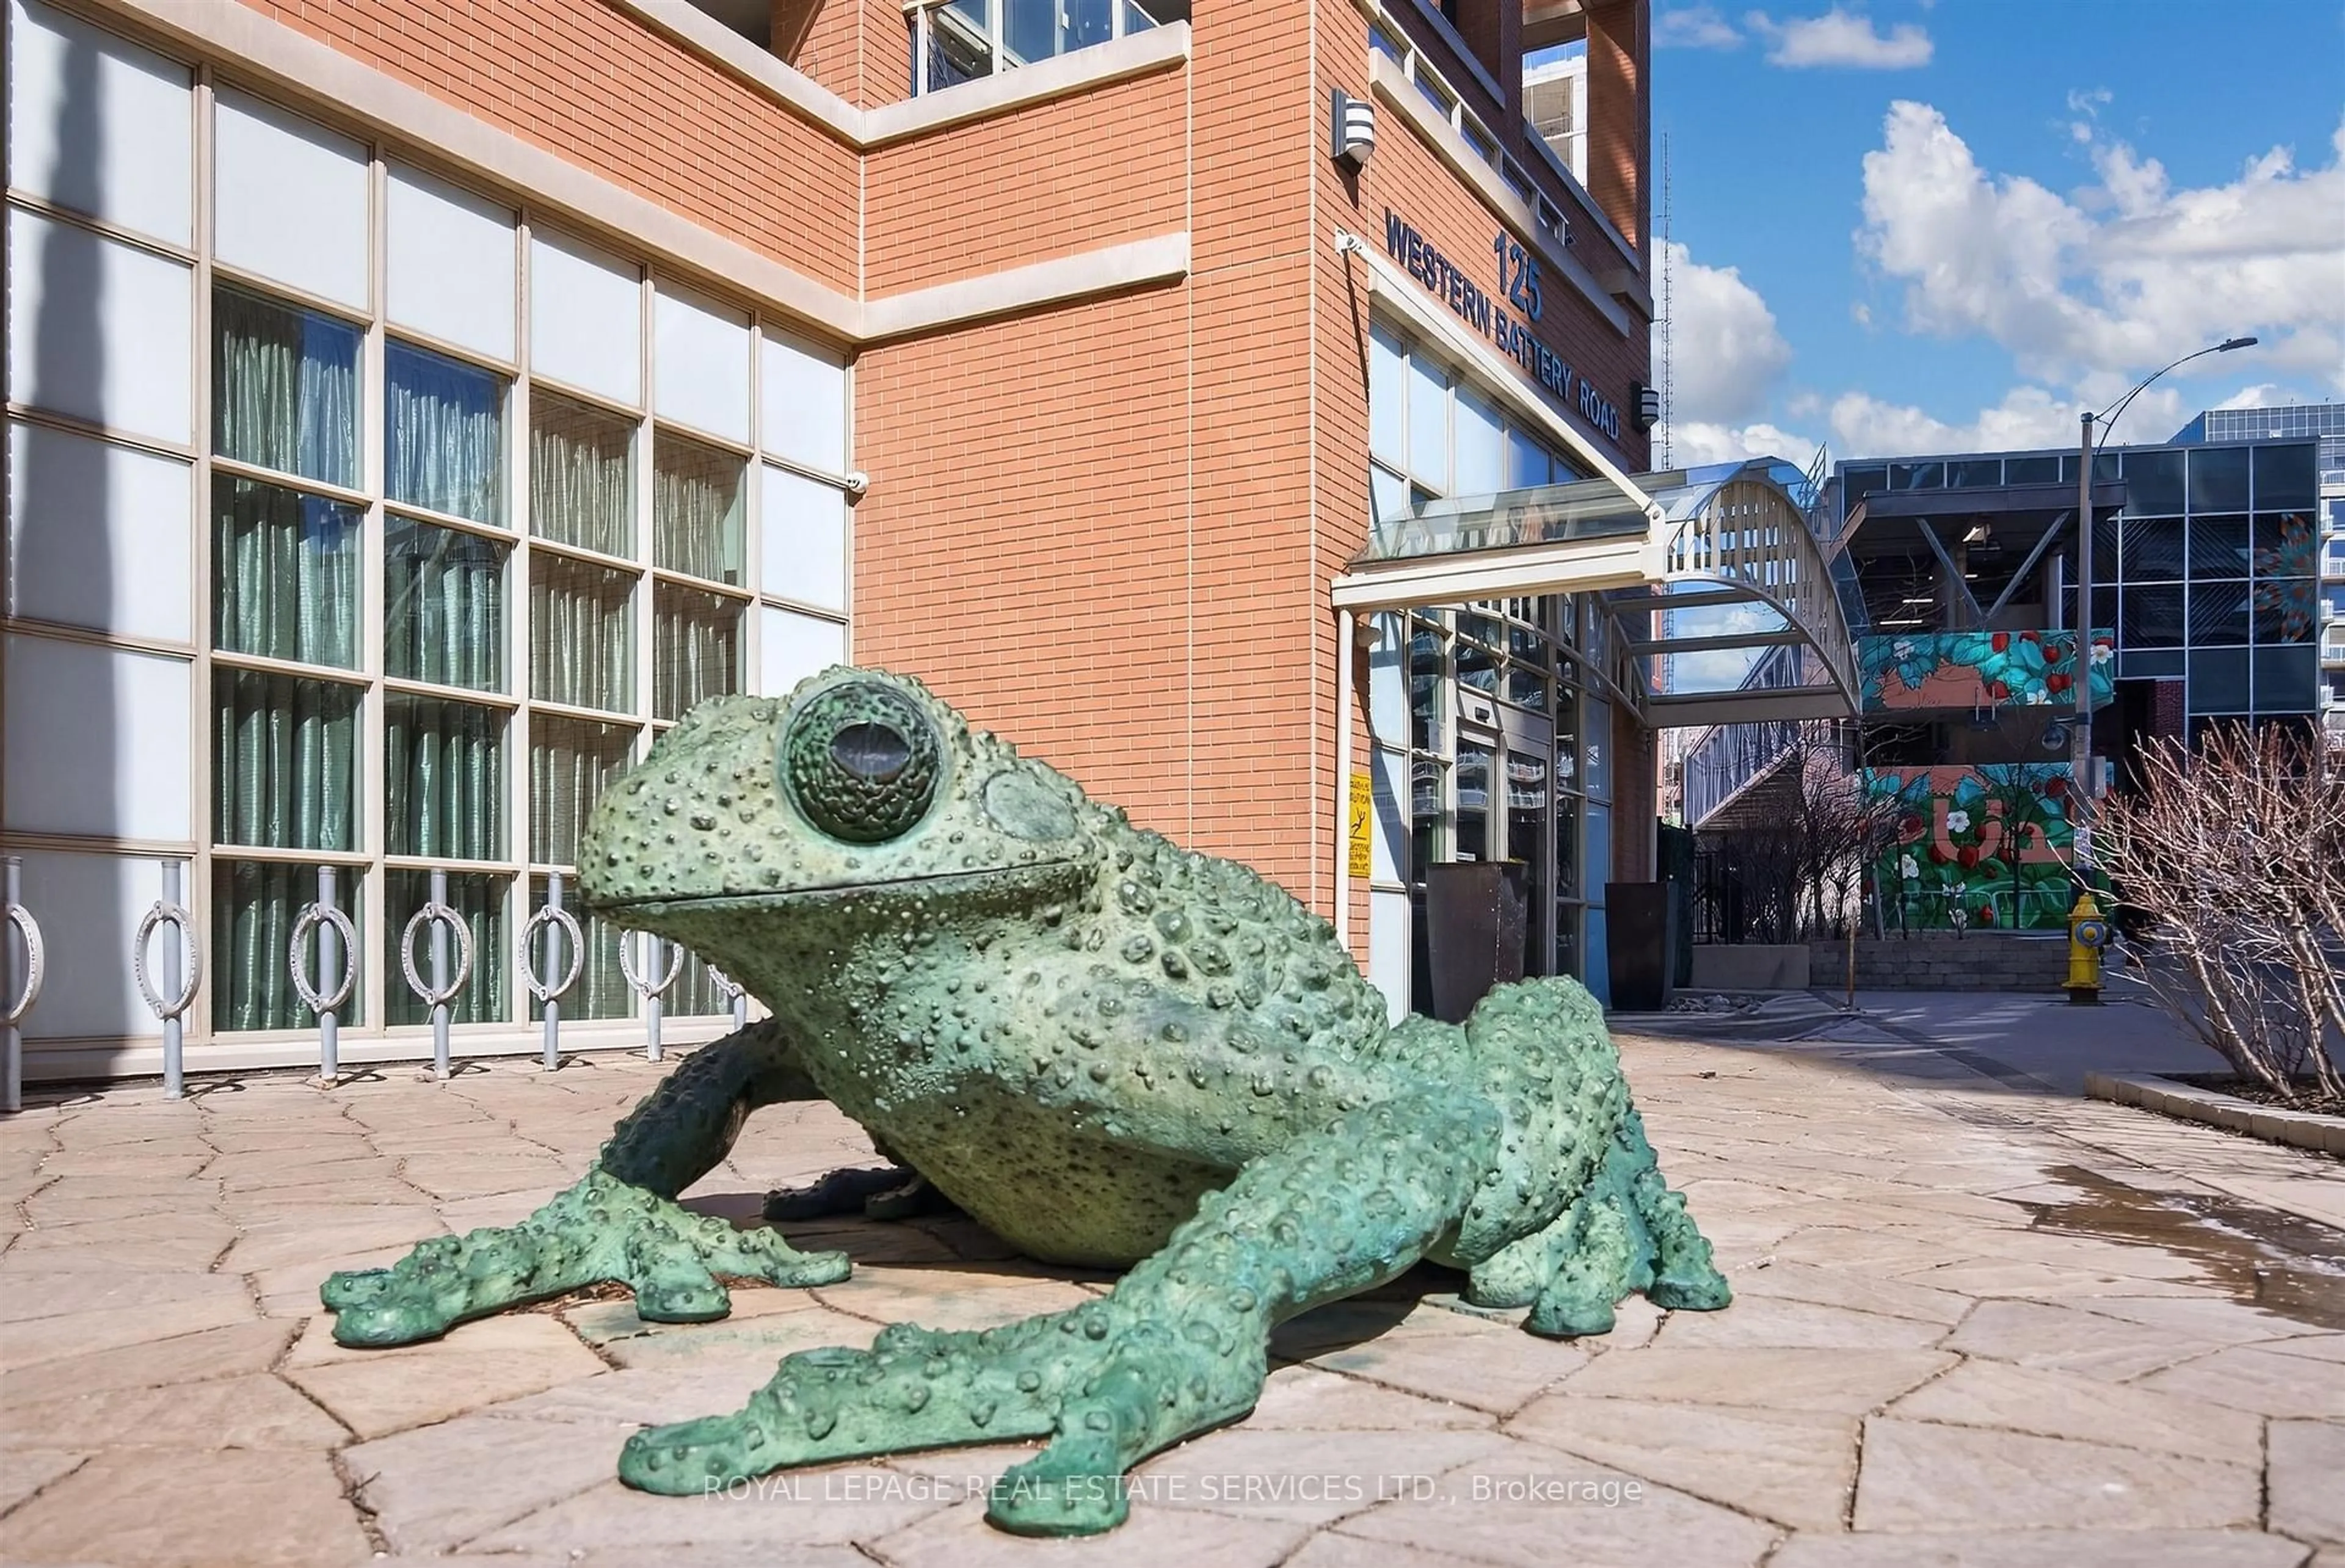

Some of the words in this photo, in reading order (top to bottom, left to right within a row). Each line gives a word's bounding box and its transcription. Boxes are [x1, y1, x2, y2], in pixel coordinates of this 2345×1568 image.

[1386, 207, 1491, 338] WESTERN
[1496, 307, 1572, 400] BATTERY
[1578, 379, 1620, 441] ROAD
[1494, 230, 1543, 323] 125
